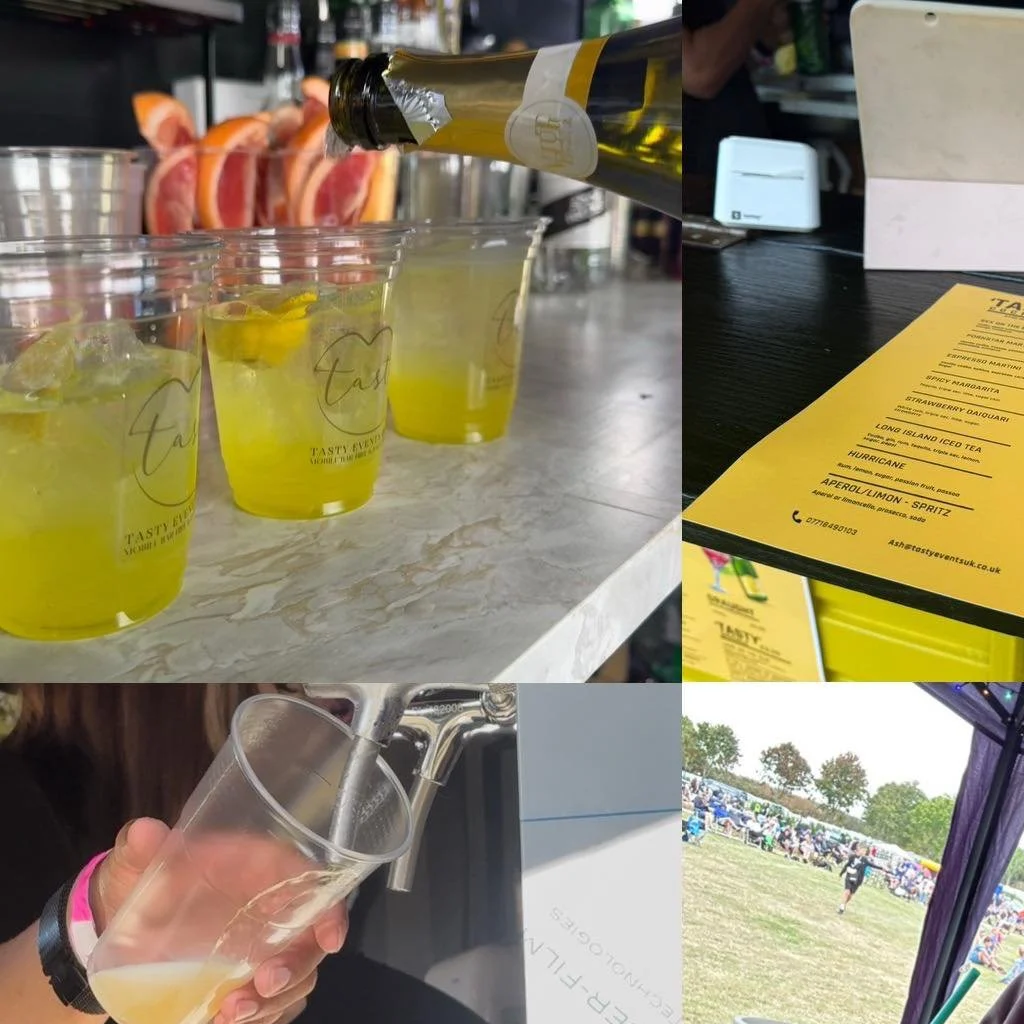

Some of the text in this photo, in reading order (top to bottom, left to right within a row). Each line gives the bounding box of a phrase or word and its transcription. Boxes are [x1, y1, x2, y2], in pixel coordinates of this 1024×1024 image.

[946, 353, 1022, 371] ESPRESSO MARTINI
[925, 375, 950, 384] SPICY
[951, 380, 1000, 394] MARGARITA
[905, 396, 965, 413] STRAWBERRY
[966, 409, 1010, 423] DAIQUARI
[310, 444, 349, 457] TASTY
[875, 423, 982, 453] LONG ISLAND ICED TEA
[847, 450, 907, 470] HURRICANE
[811, 489, 834, 498] Aperol
[876, 506, 909, 519] prosecco,
[909, 514, 926, 523] soda
[820, 478, 902, 504] APEROL/LIMON
[911, 501, 952, 517] SPRITZ
[124, 522, 170, 545] TASTY
[887, 538, 1002, 574] Ash@tastyeventsuk.co.uk
